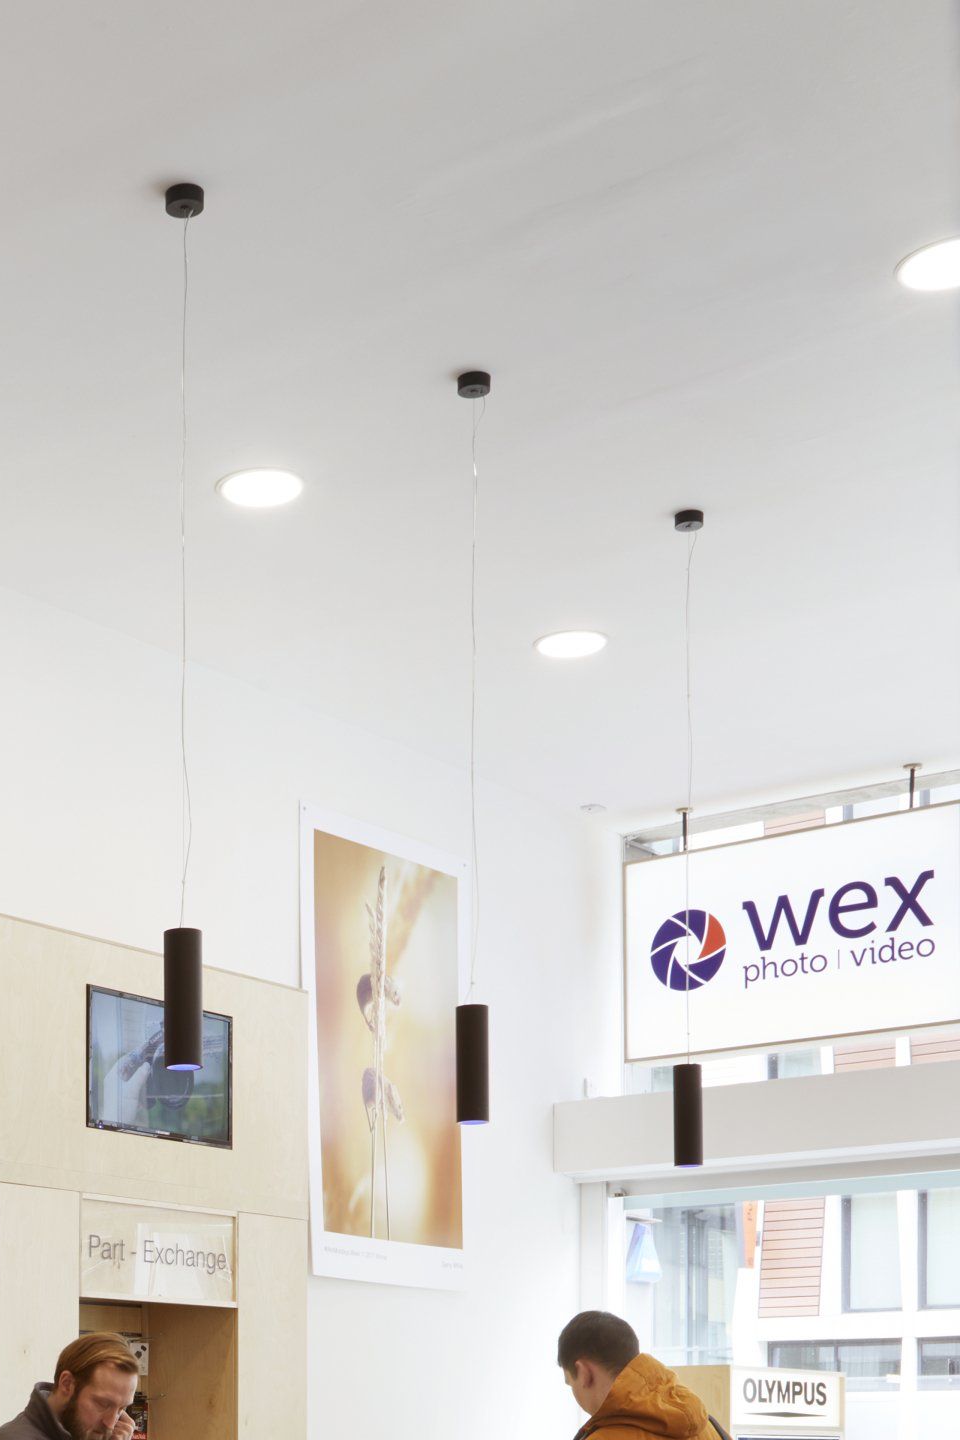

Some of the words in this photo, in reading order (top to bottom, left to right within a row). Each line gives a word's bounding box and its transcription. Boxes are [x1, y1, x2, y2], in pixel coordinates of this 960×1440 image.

[742, 869, 935, 951] wex
[742, 951, 828, 989] photo
[849, 937, 936, 967] video
[88, 1234, 125, 1262] Part
[143, 1239, 227, 1275] Exchange
[742, 1378, 828, 1406] OLYMPUS
